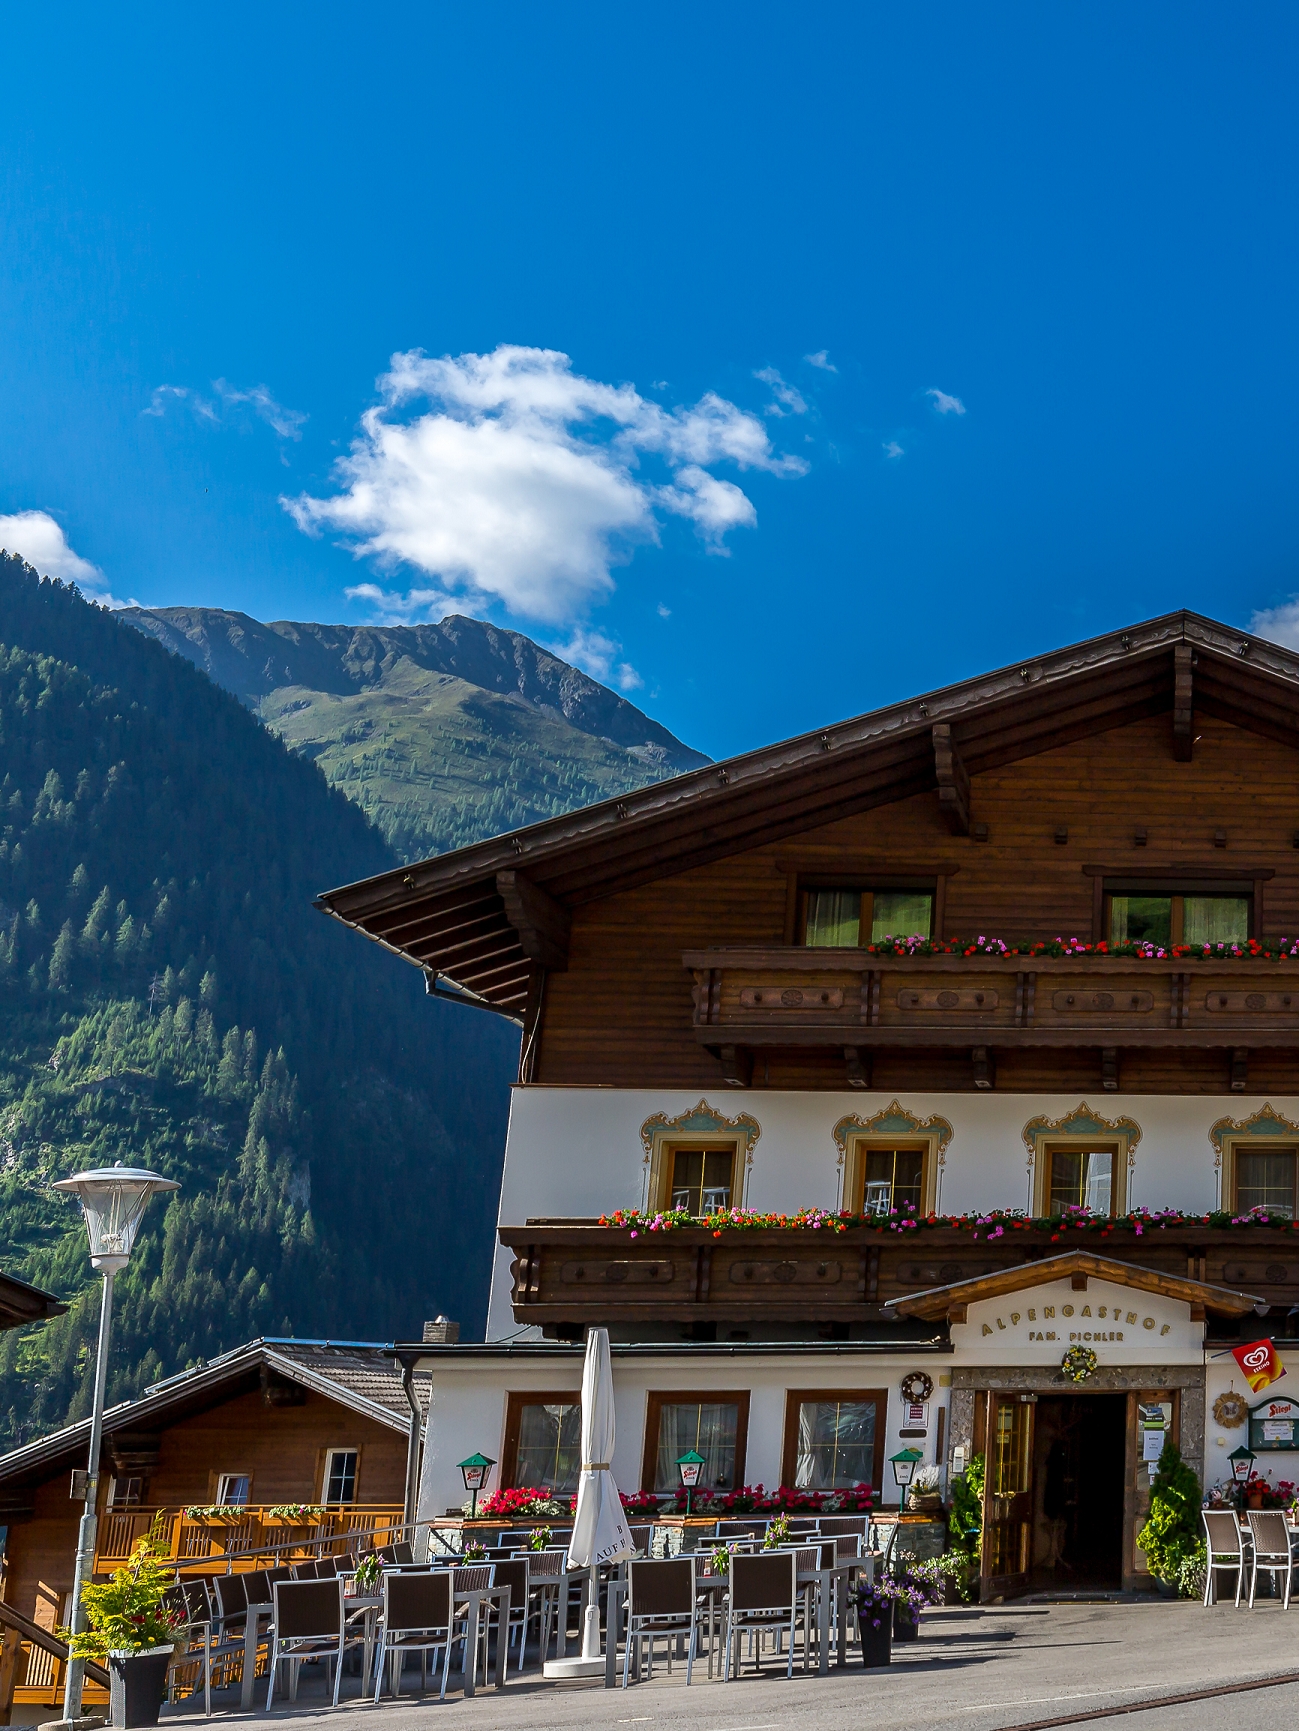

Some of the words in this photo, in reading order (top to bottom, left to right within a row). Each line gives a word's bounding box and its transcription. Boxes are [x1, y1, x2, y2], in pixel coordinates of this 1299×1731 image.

[982, 1304, 1171, 1337] ALPENGASTHOF
[1029, 1331, 1060, 1341] FAM.
[1069, 1332, 1124, 1342] PICHLER
[1269, 1403, 1292, 1418] Stiegl
